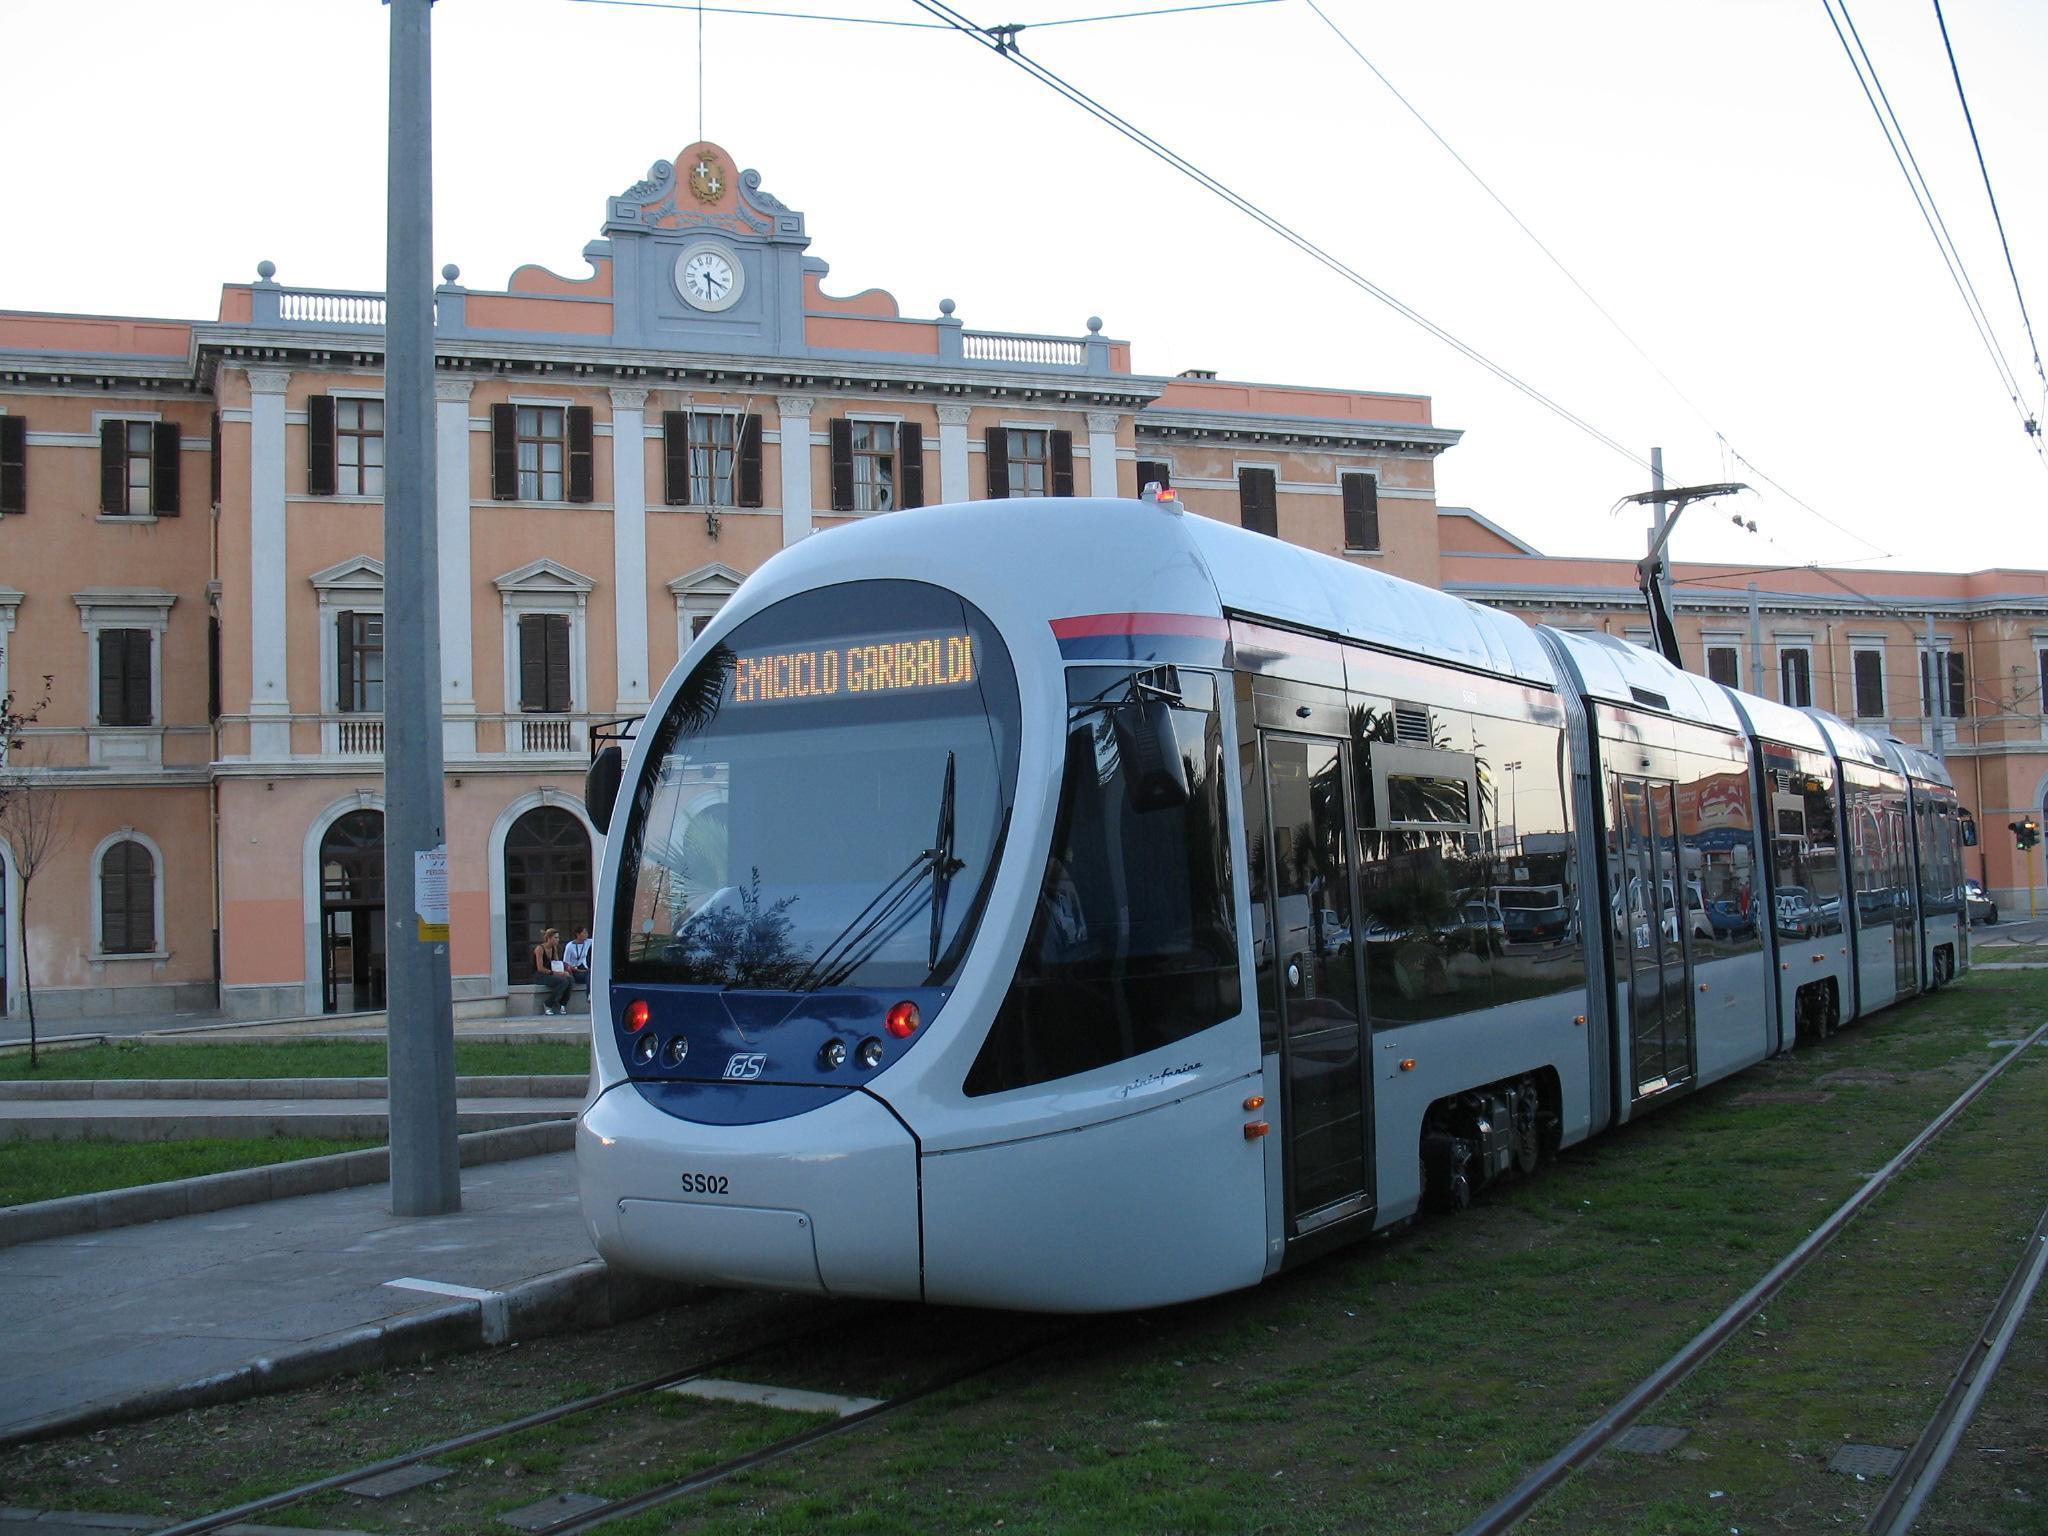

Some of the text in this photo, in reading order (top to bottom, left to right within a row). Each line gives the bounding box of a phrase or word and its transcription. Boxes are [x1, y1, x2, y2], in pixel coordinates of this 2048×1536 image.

[735, 636, 972, 702] EMICICLO GARIBALDI
[681, 1173, 729, 1195] SS02
